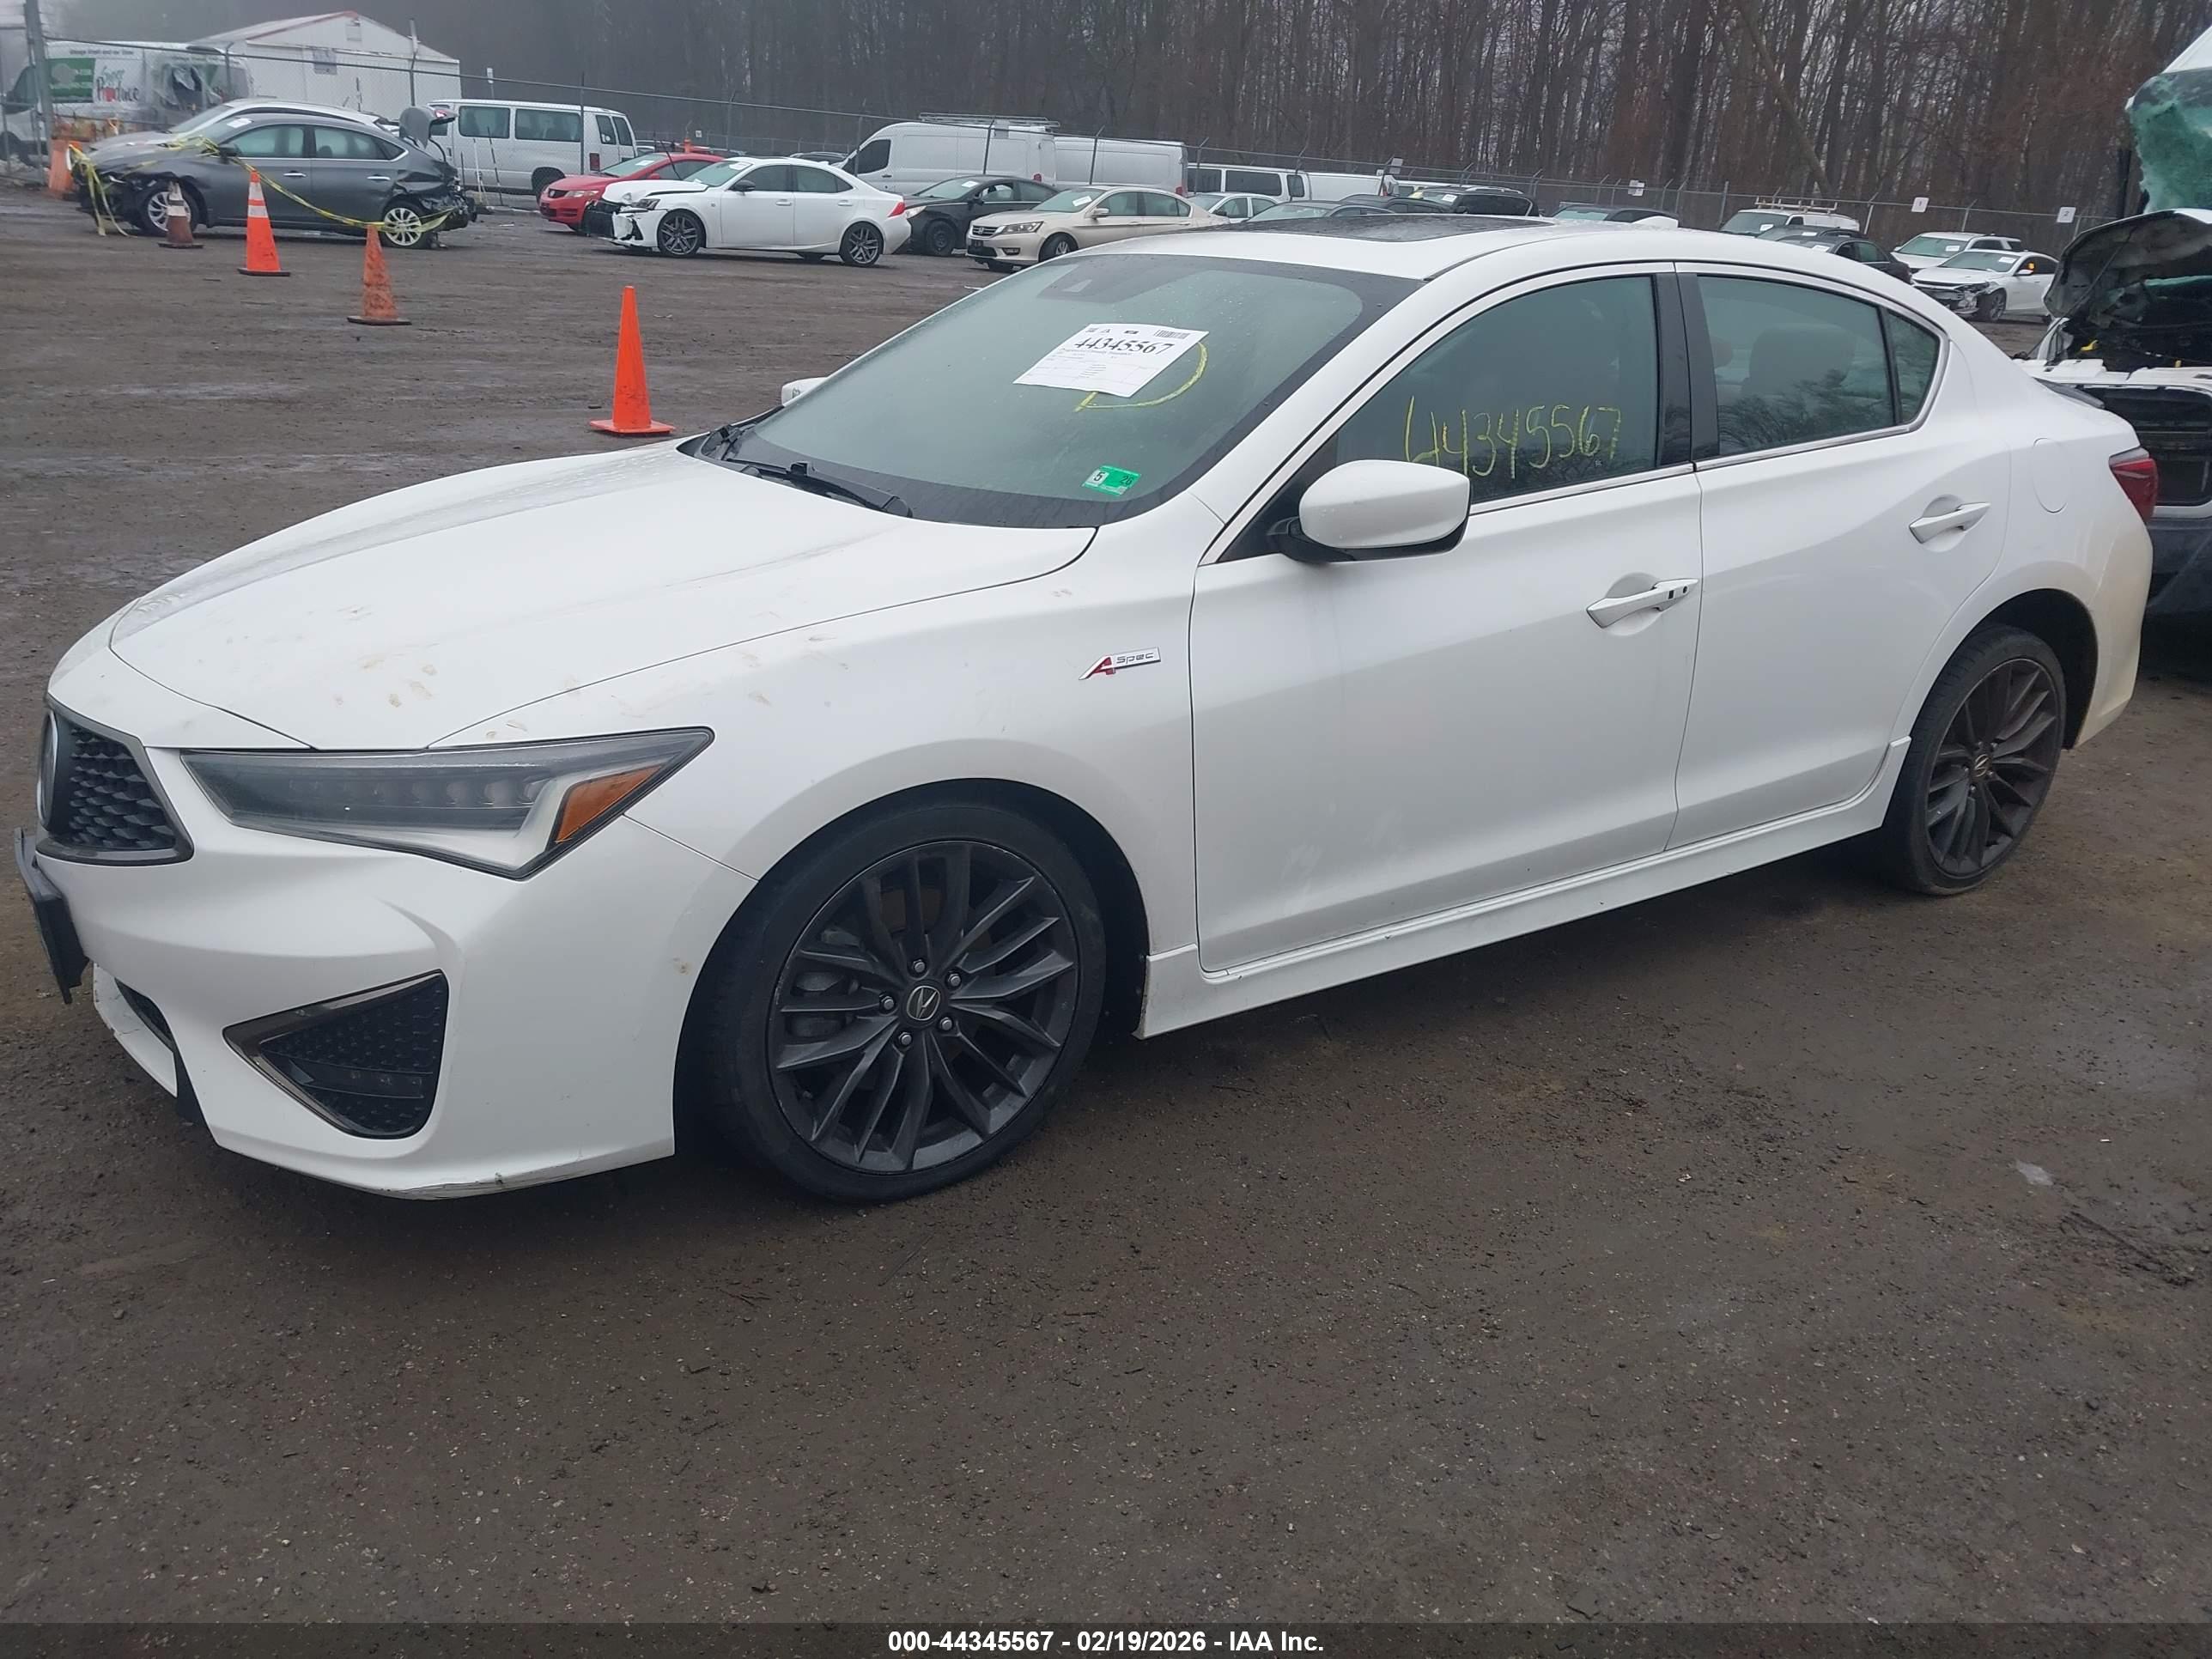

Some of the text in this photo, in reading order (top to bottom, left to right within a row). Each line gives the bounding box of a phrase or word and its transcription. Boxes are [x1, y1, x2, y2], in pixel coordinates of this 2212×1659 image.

[1074, 337, 1175, 356] 44345567
[1404, 395, 1622, 479] 44345567
[1093, 471, 1134, 486] 5 26
